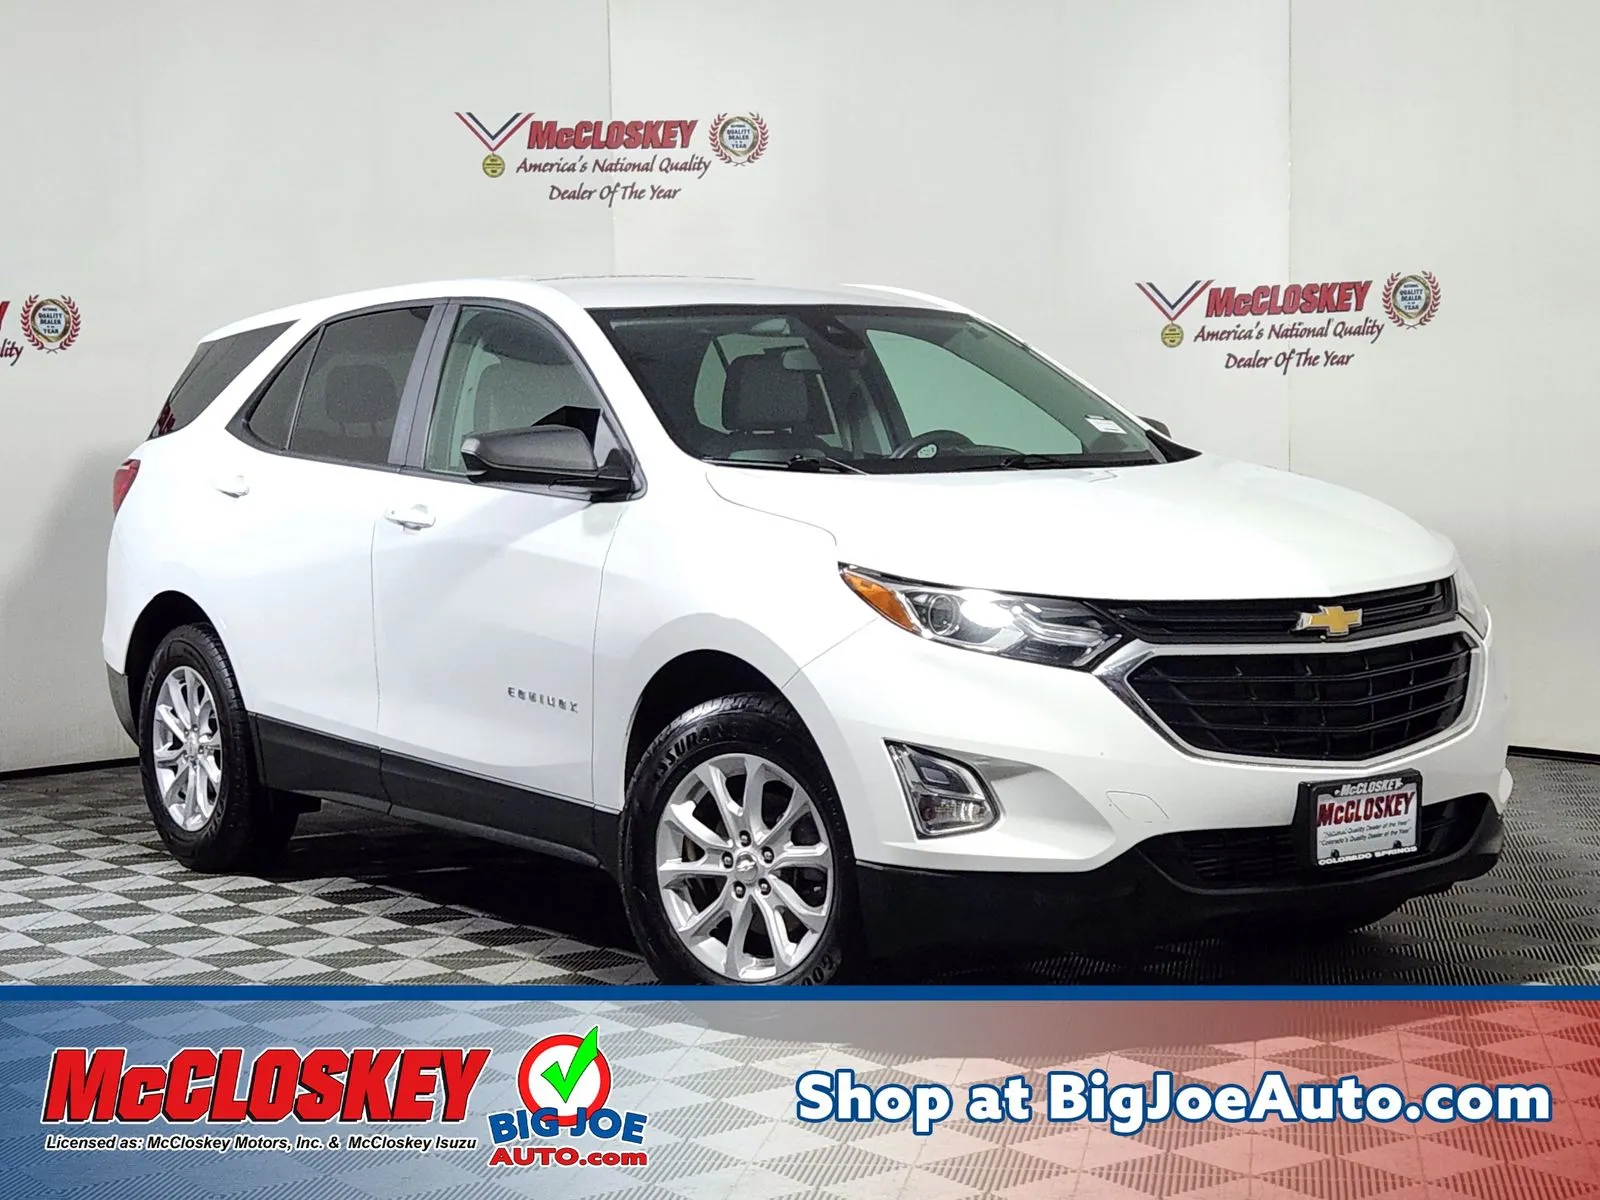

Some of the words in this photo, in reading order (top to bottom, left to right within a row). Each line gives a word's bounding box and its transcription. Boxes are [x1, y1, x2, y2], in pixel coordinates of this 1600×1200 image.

[527, 120, 698, 150] McCLOSKEY
[516, 154, 588, 174] America's
[592, 154, 653, 174] National
[658, 154, 712, 179] Quality
[549, 184, 597, 201] Dealer
[599, 183, 620, 208] Of
[617, 184, 646, 200] The
[650, 184, 682, 201] Year
[1205, 280, 1373, 318] McCLOSKEY
[1193, 320, 1264, 342] America's
[1267, 321, 1329, 340] National
[1333, 317, 1385, 344] Quality
[1225, 351, 1273, 370] Dealer
[1275, 349, 1296, 375] Of
[1294, 350, 1320, 367] The
[1324, 350, 1355, 367] Year
[1340, 778, 1402, 796] McCLOSKEY
[1317, 791, 1416, 827] McCLOSKEY
[1318, 852, 1372, 866] COLORADO
[1374, 846, 1418, 858] SPRINGS
